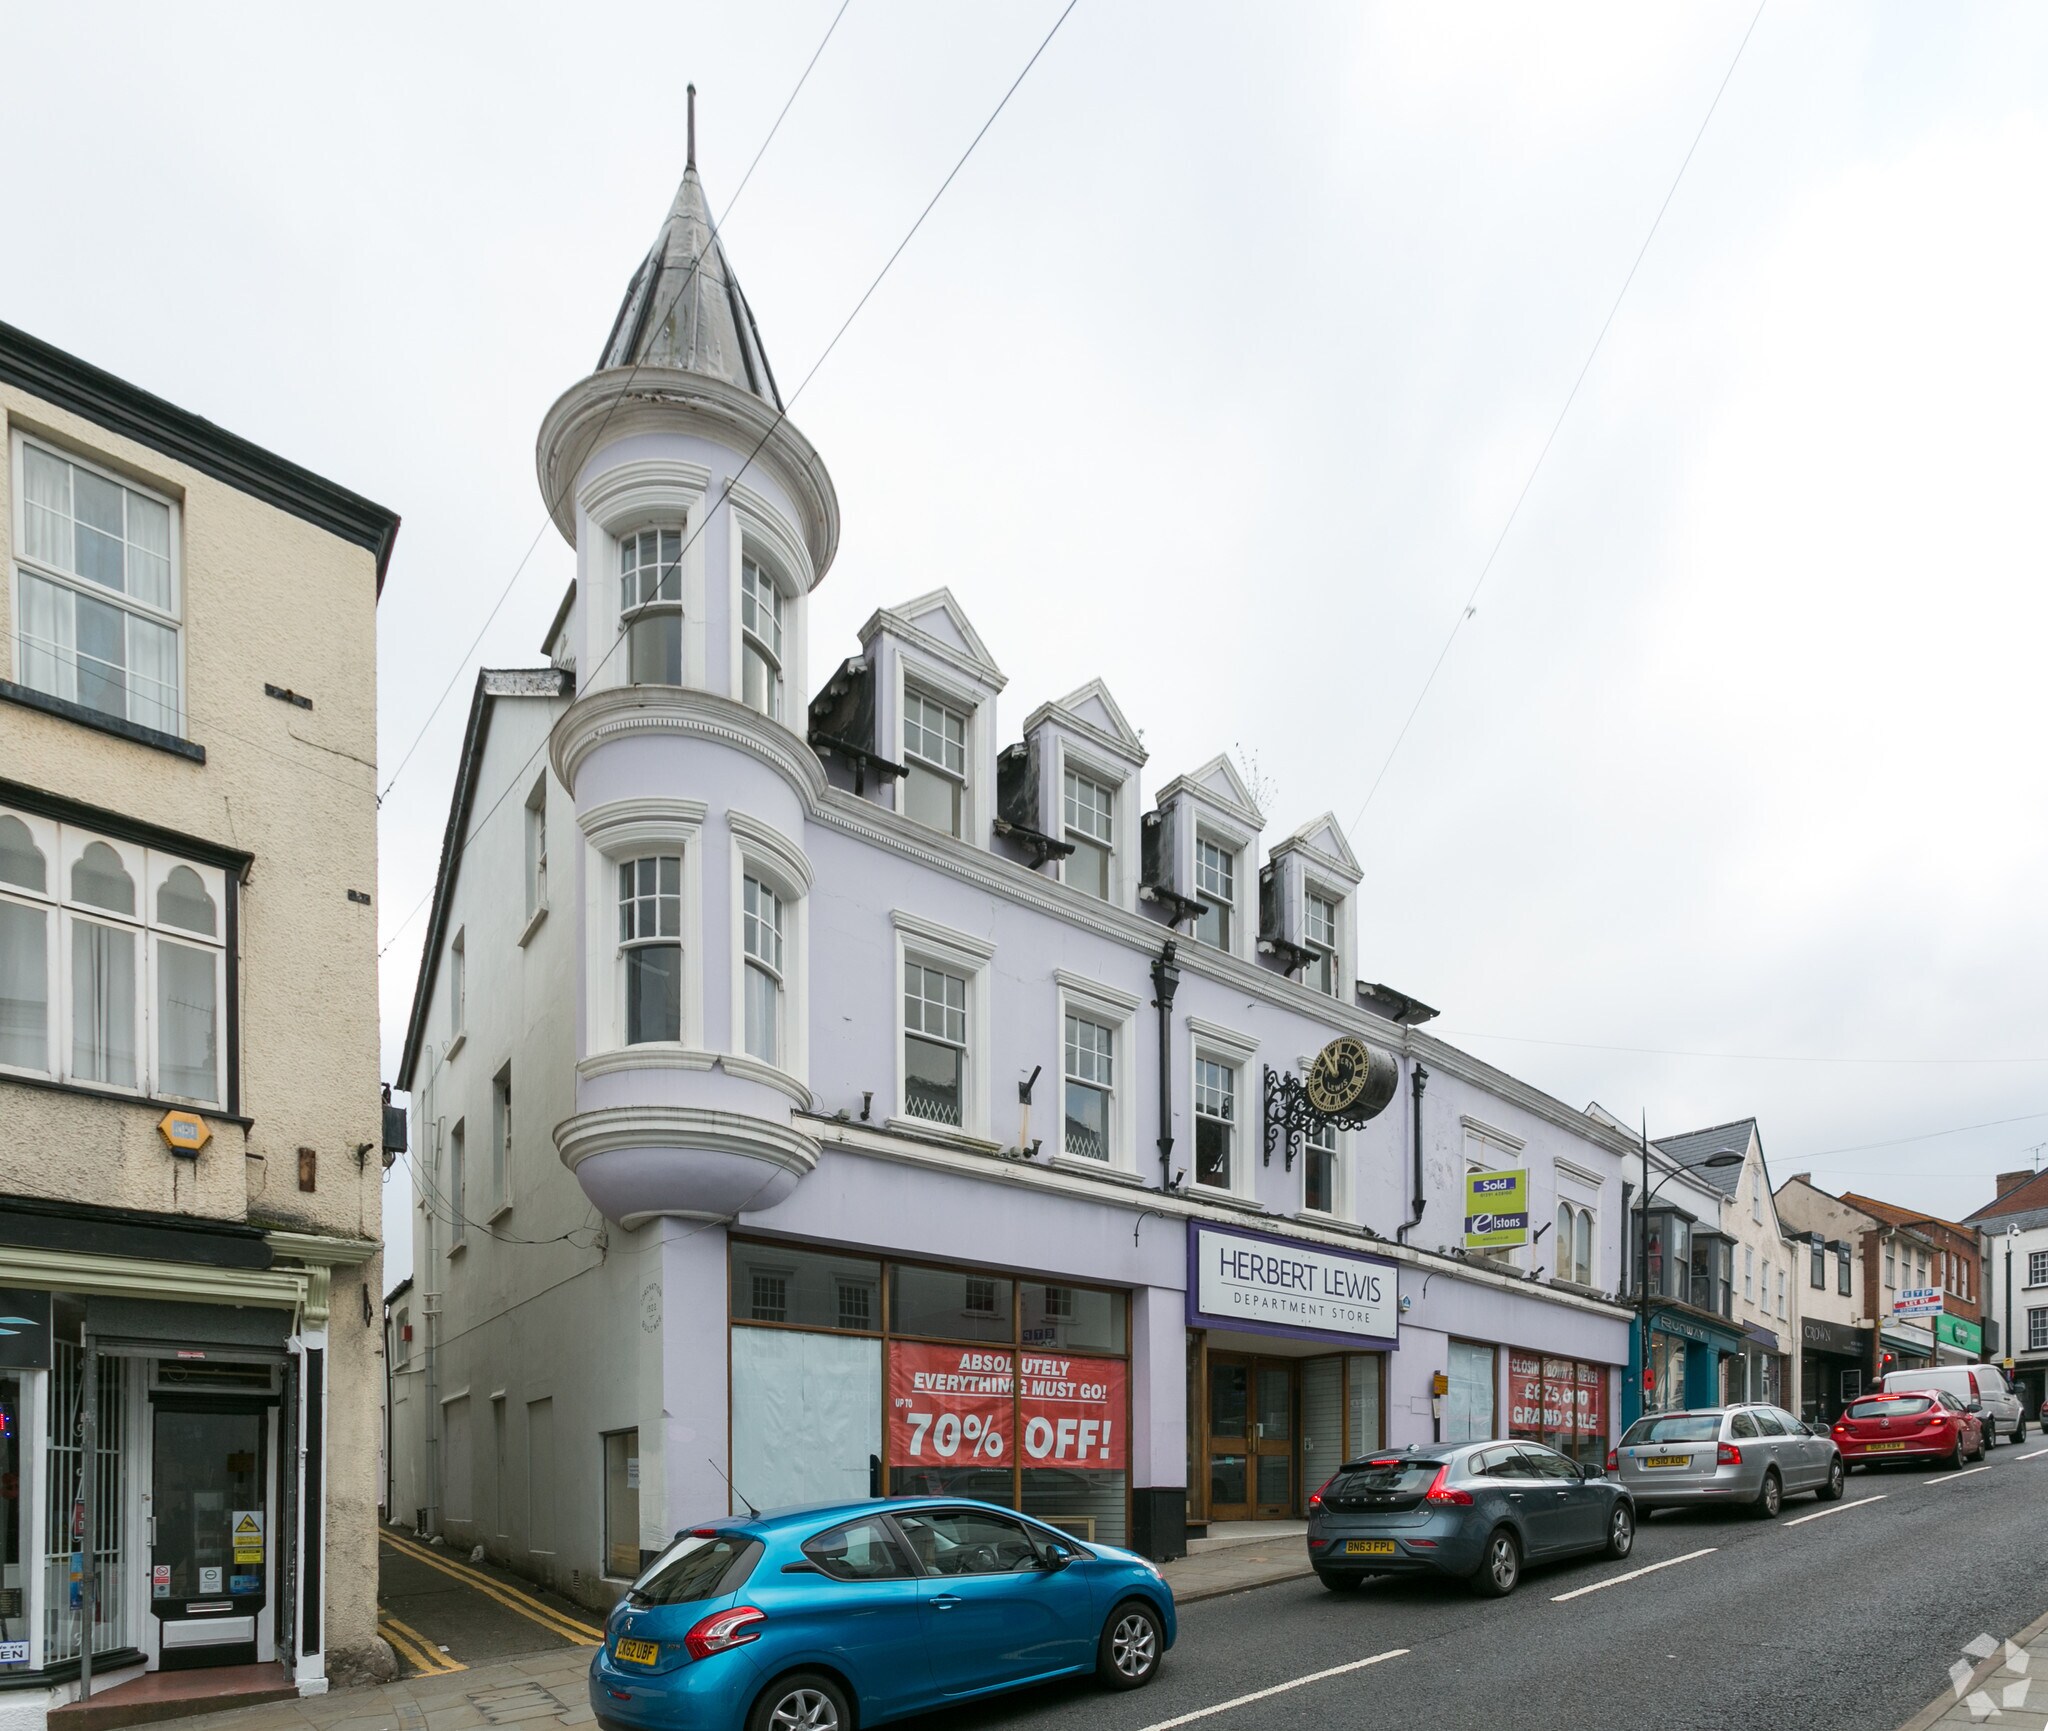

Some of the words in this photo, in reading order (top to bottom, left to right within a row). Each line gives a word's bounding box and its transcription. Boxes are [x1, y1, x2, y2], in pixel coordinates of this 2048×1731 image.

[1327, 1078, 1348, 1092] LEWIS
[1483, 1179, 1507, 1191] Sold
[1472, 1214, 1520, 1235] elstons
[1220, 1248, 1318, 1291] HERBERT
[1324, 1268, 1381, 1302] LEWIS
[1234, 1292, 1324, 1316] DEPARTMENT
[1332, 1307, 1370, 1323] STORE
[1804, 1325, 1831, 1342] CROWN
[959, 1353, 1070, 1377] ABSOLUTELY
[1511, 1358, 1546, 1376] CLOSIN
[914, 1372, 1027, 1395] EVERYTHING
[1032, 1380, 1076, 1398] MUST
[1080, 1383, 1107, 1399] GO!
[895, 1398, 905, 1408] UP
[905, 1398, 913, 1409] TO
[1513, 1406, 1562, 1426] GRAND
[1565, 1410, 1598, 1429] SALE
[906, 1412, 1004, 1458] 70%
[1025, 1416, 1112, 1460] OFF!
[1347, 1541, 1372, 1552] BN63
[1373, 1541, 1393, 1551] FPL
[636, 1642, 654, 1660] UBF
